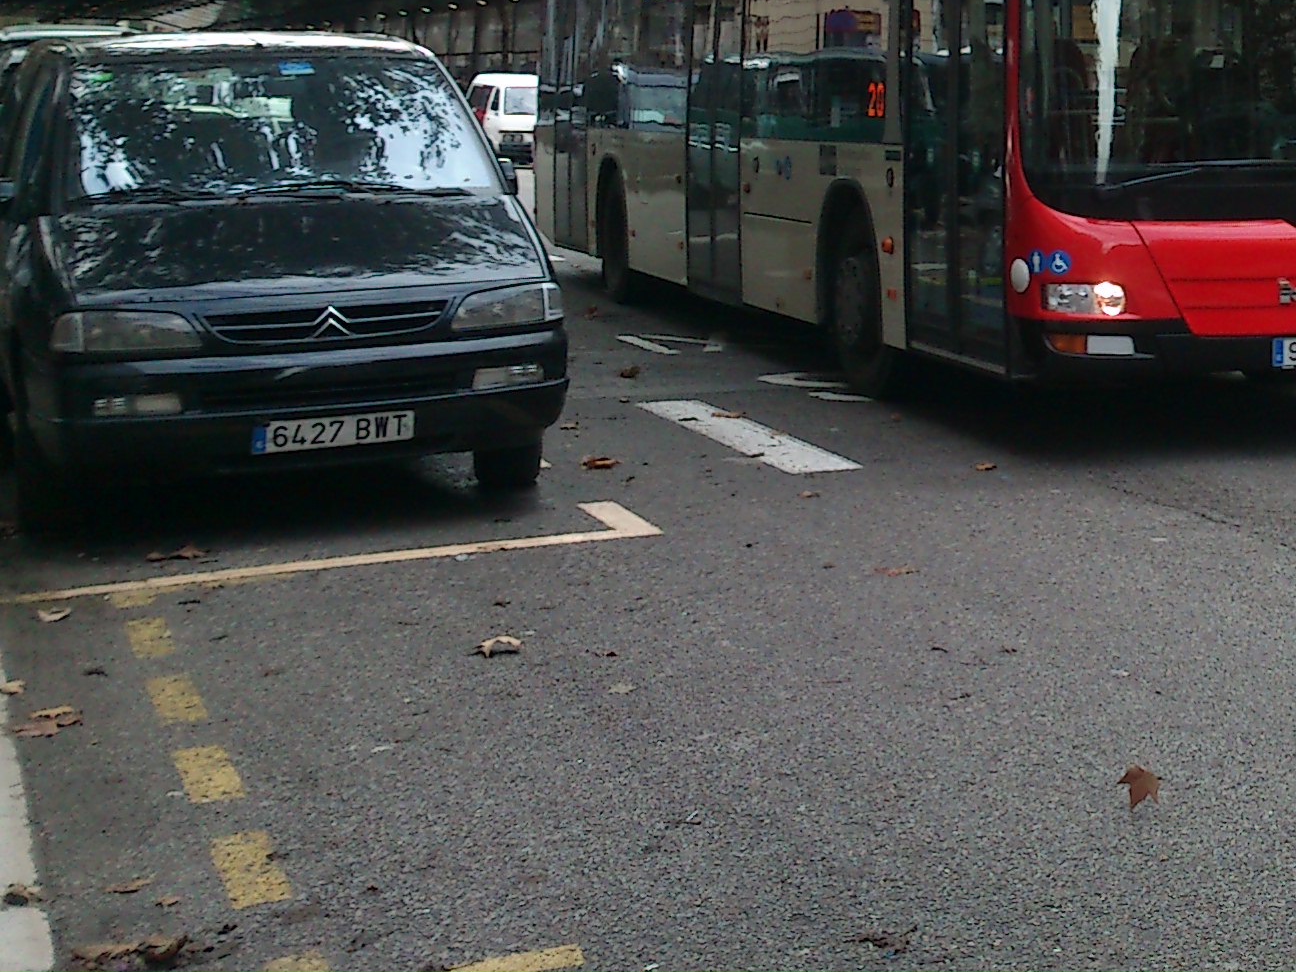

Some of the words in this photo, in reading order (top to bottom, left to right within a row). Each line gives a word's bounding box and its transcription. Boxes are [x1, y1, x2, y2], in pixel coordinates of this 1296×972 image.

[868, 82, 885, 117] 20
[272, 420, 345, 448] 6427
[355, 414, 408, 440] BWT
